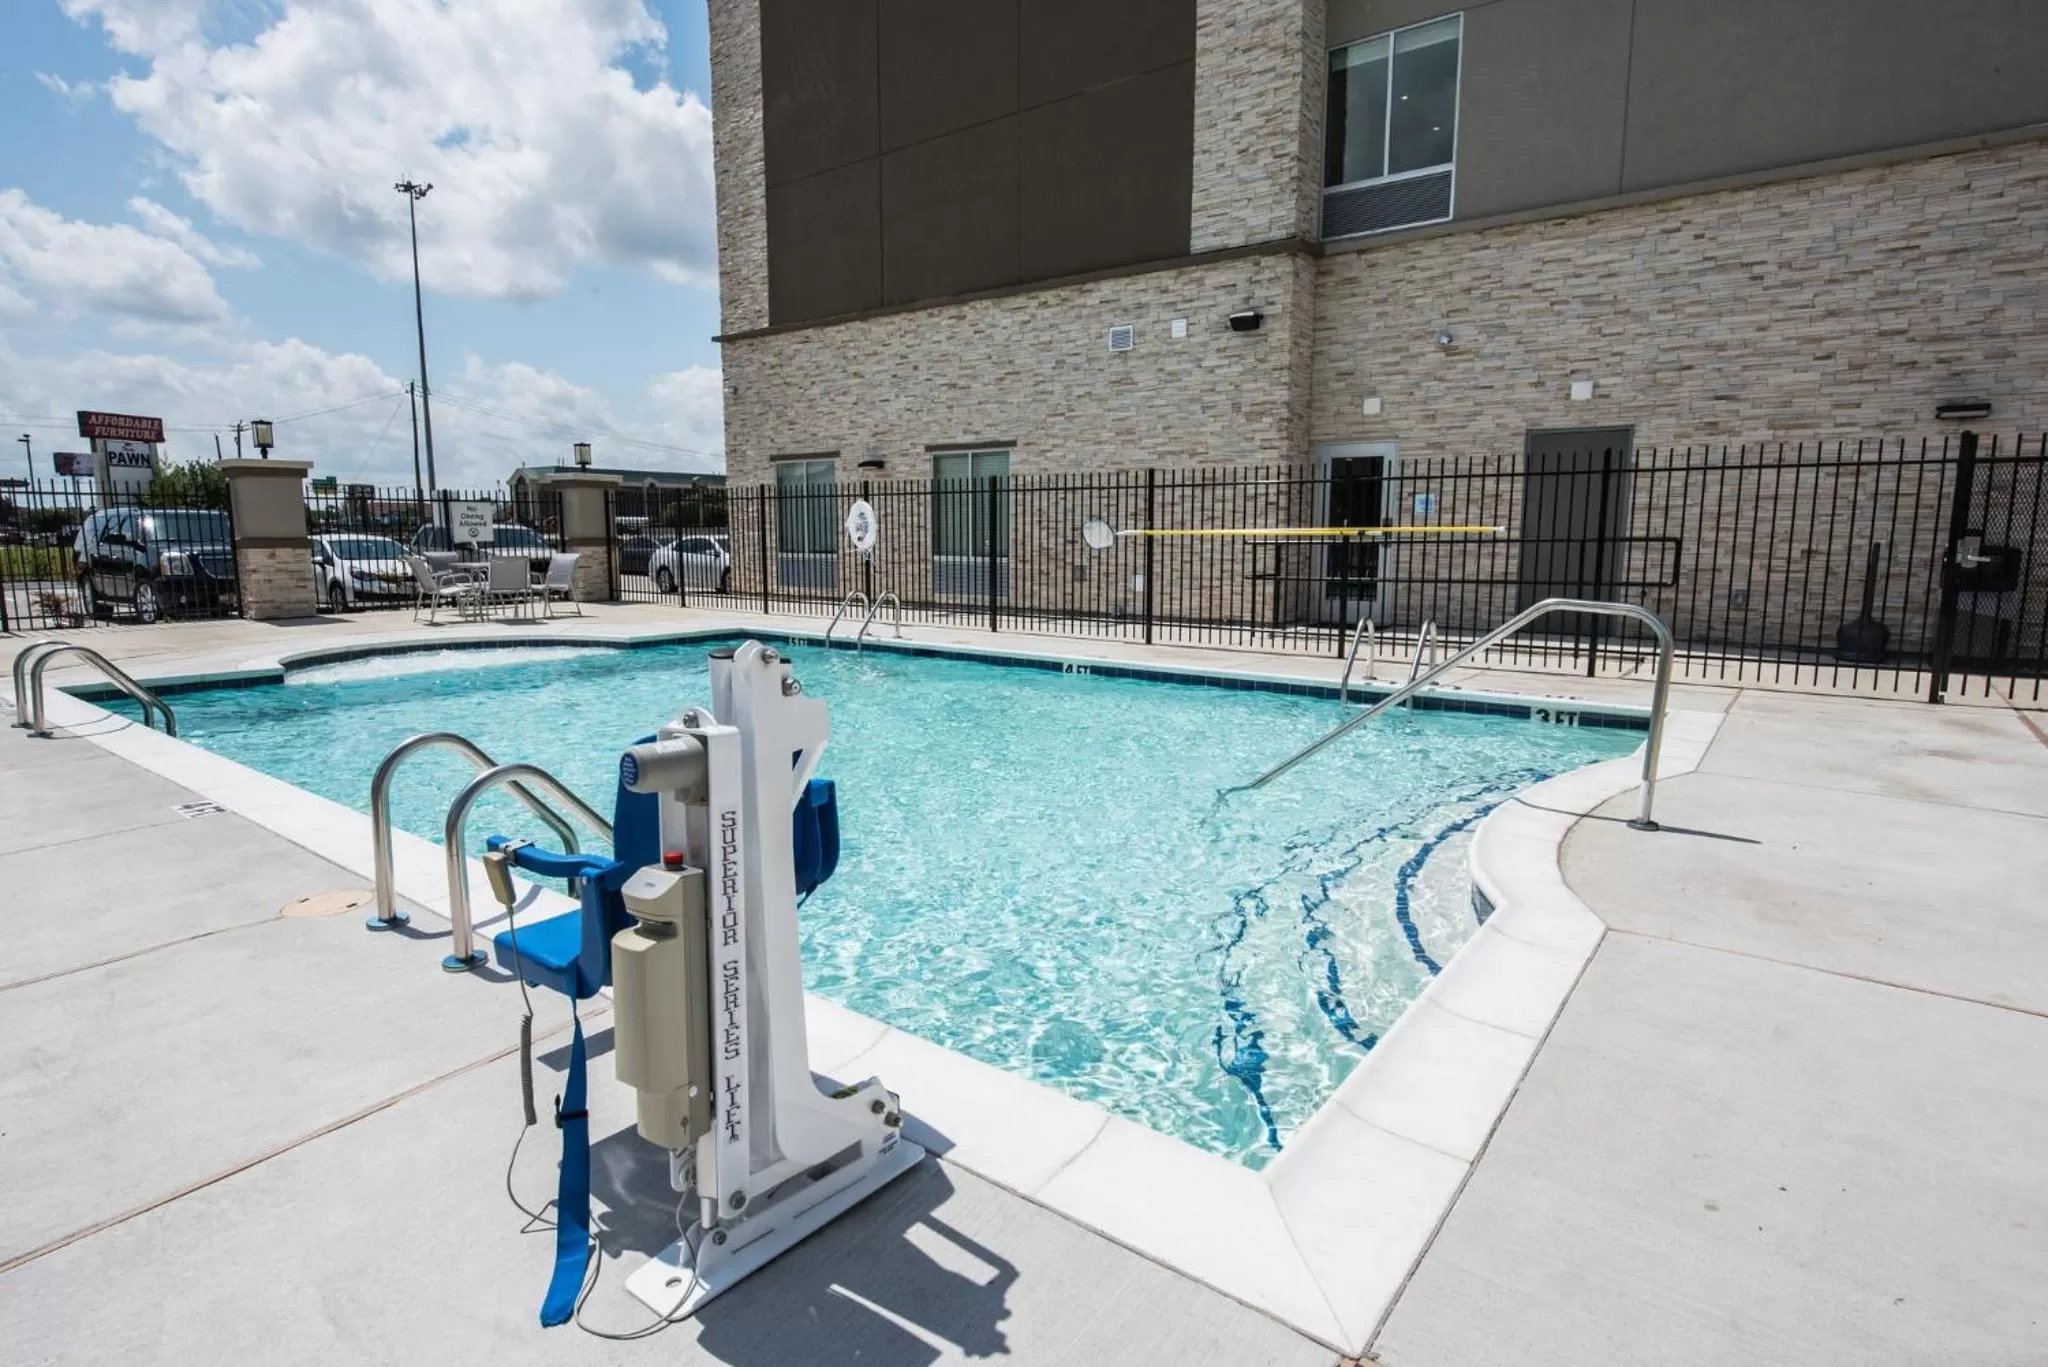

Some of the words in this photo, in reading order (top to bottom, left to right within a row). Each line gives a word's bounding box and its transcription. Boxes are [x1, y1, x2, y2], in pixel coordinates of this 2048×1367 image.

[88, 414, 160, 430] AFFORDABLE
[94, 426, 157, 440] FURNITURE
[108, 451, 151, 466] PAWN
[459, 520, 487, 528] Allowed
[460, 513, 485, 521] Diving
[1077, 665, 1090, 675] FT
[1536, 708, 1551, 723] 3
[1555, 710, 1578, 727] FT
[721, 810, 739, 947] SUPERIOR
[723, 960, 741, 1060] SERIES
[725, 1074, 741, 1145] LIFT
